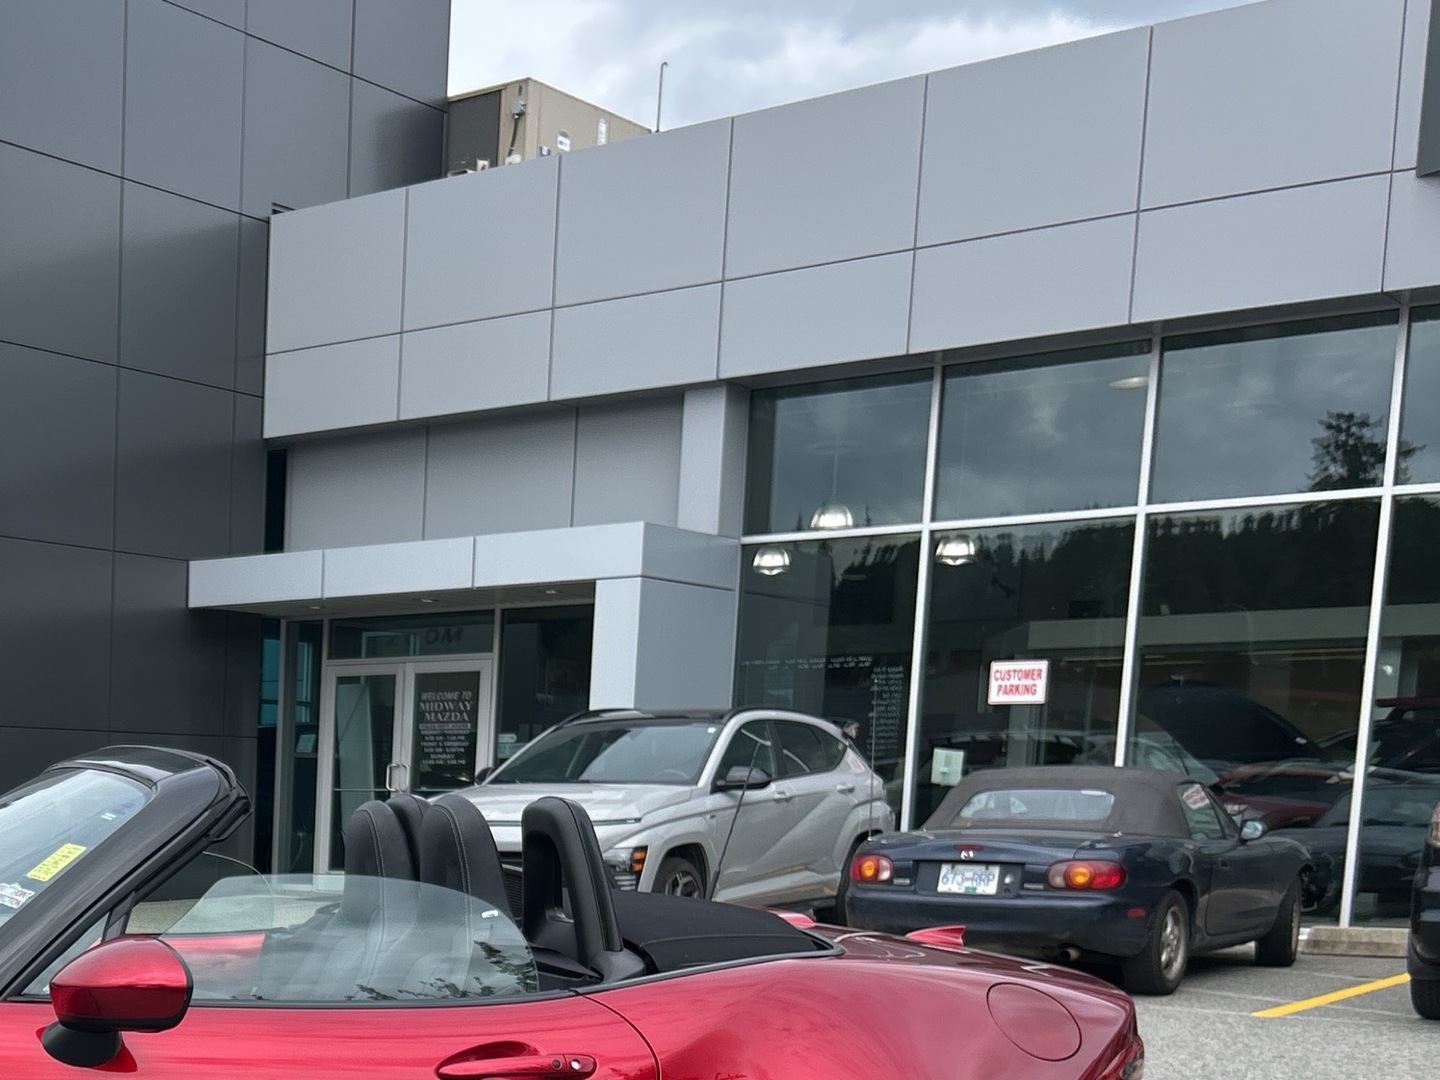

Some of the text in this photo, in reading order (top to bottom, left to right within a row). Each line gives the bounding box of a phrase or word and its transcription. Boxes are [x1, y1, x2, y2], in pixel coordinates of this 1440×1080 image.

[993, 668, 1043, 682] CUSTOMER
[996, 683, 1038, 697] PARKING
[421, 691, 472, 701] WELCOME TO
[419, 701, 472, 711] MIDWAY
[423, 712, 469, 721] MAZDA
